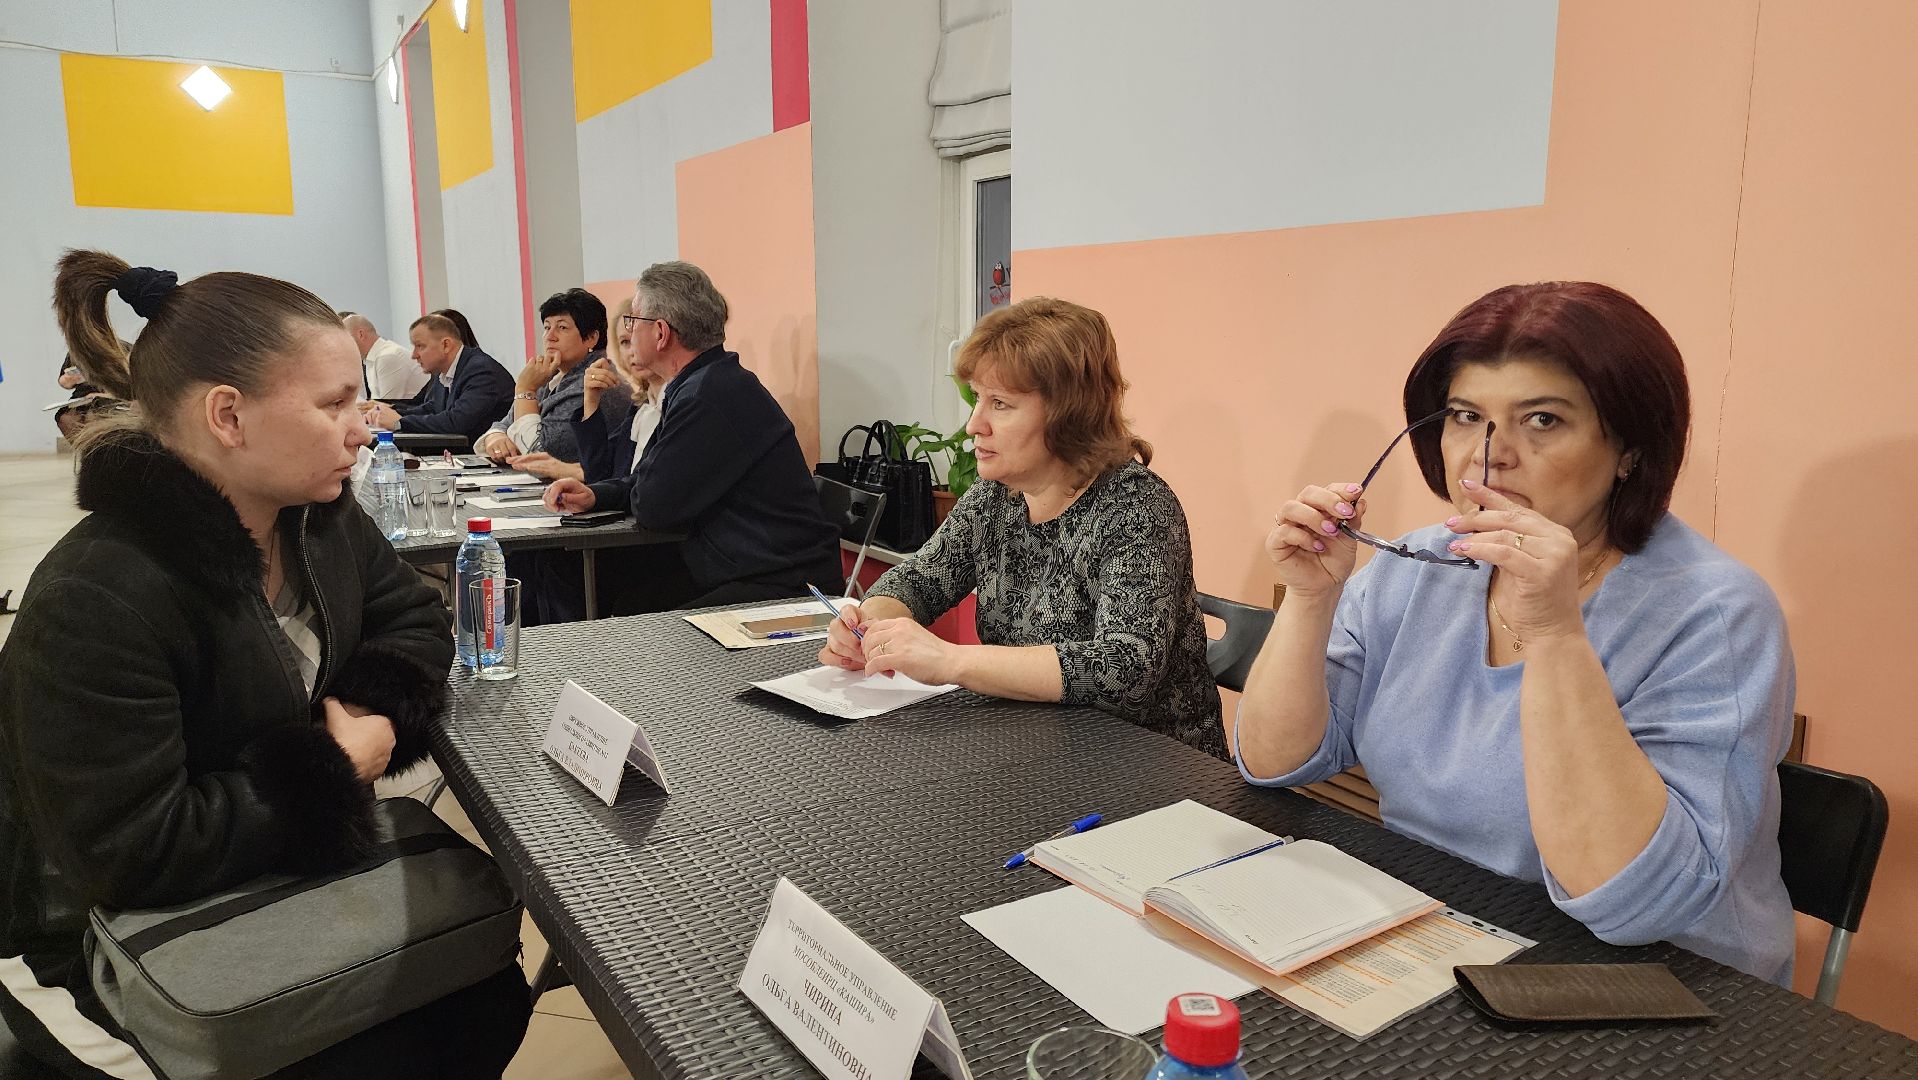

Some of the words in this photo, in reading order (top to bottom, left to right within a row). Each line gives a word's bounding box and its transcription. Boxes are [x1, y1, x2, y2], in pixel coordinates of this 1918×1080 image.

[762, 973, 791, 1010] ОЛЬГА
[787, 918, 850, 979] ТЕРРИТОРИАЛЬНОЕ
[849, 968, 898, 1021] УПРАВЛЕНИЕ
[793, 945, 838, 991] МОСОБЛЕИРЦ
[837, 986, 875, 1024] «КАШИРА»
[804, 979, 842, 1026] ЧИРИНА
